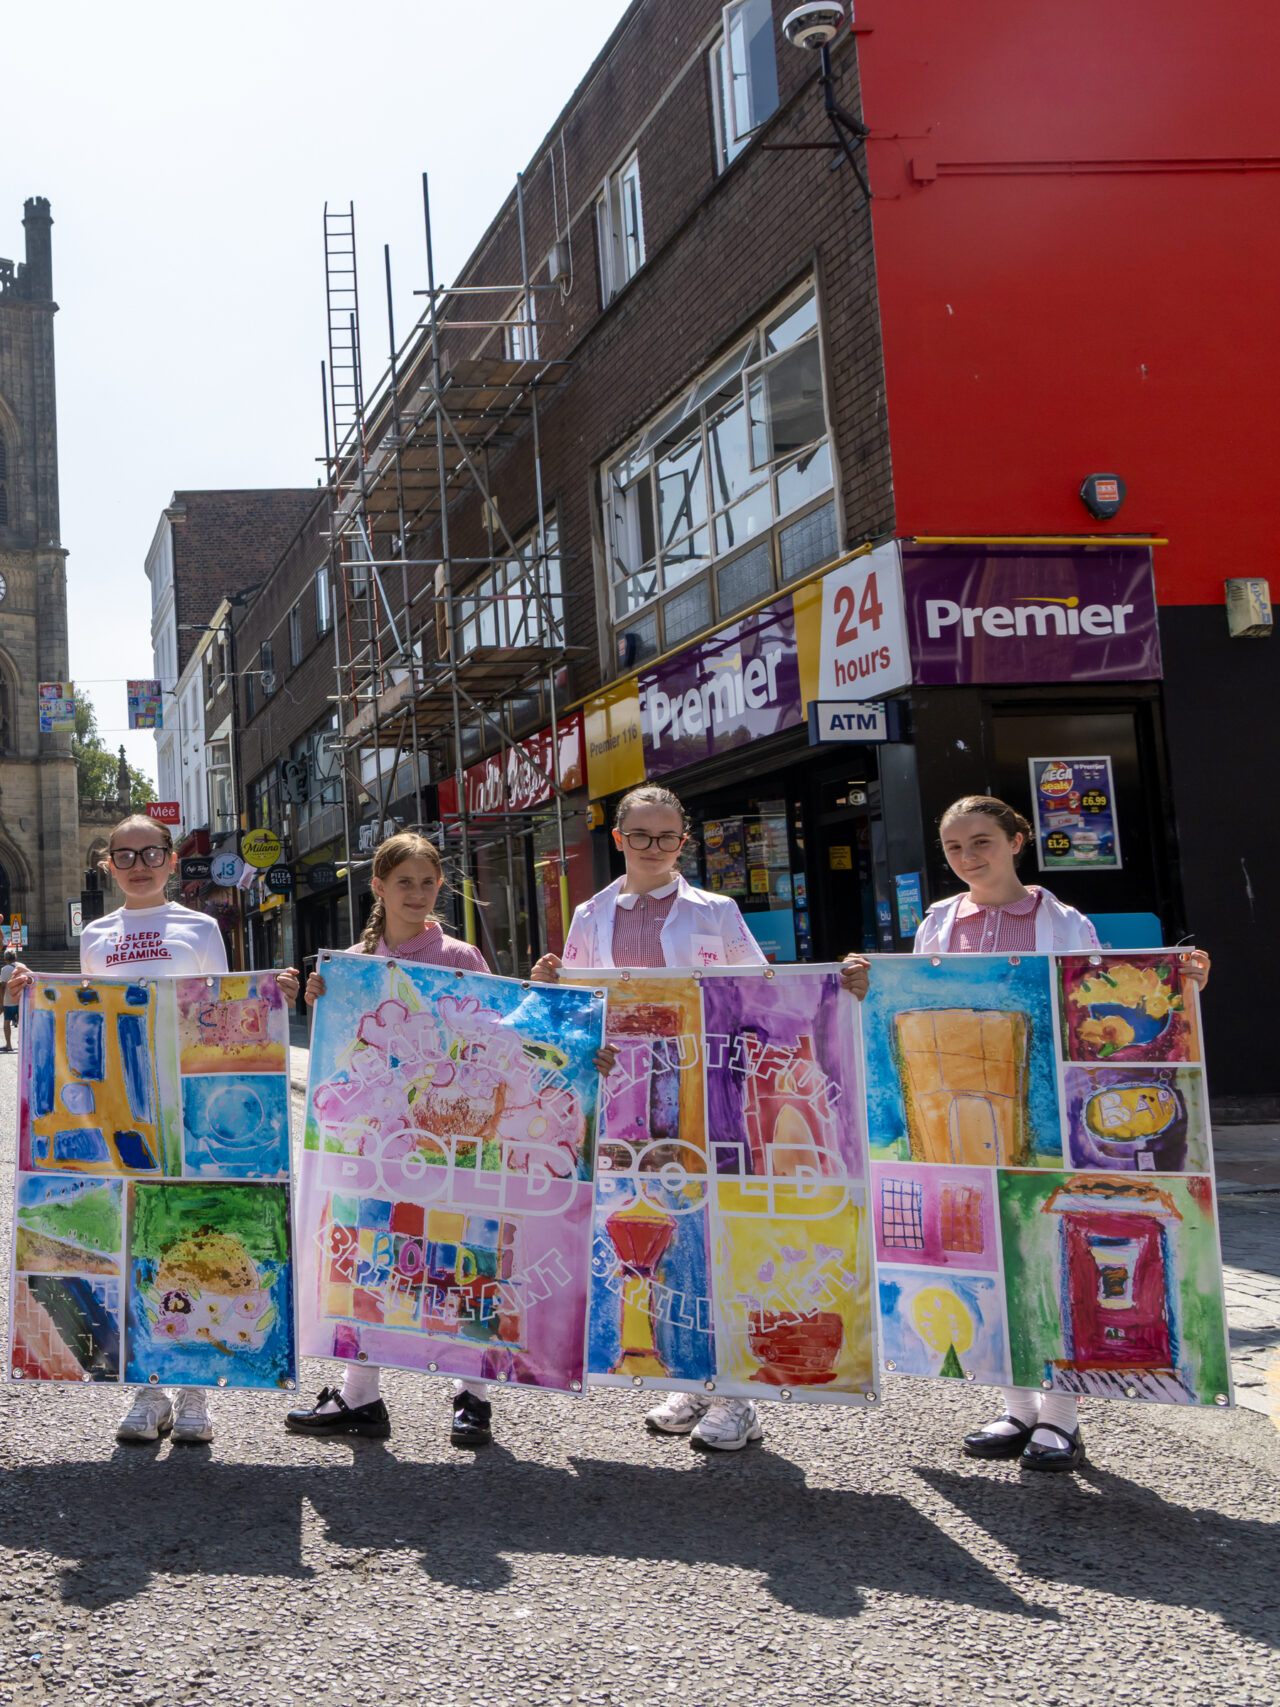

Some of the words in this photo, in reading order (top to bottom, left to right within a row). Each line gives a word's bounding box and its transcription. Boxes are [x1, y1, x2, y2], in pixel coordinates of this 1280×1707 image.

[833, 571, 884, 647] 24
[925, 596, 1134, 639] Premier
[834, 645, 891, 686] hours
[650, 646, 783, 749] Premier
[590, 732, 621, 758] Premier
[622, 724, 638, 743] 116
[828, 711, 878, 732] ATM
[1041, 767, 1073, 783] MEGA
[1082, 796, 1107, 806] £6.99
[1048, 840, 1070, 849] £1.25
[880, 910, 892, 920] blu
[106, 948, 171, 964] DREAMING.
[114, 943, 130, 952] TO
[132, 940, 163, 949] KEEP
[126, 932, 160, 941] SLEEP
[324, 1028, 582, 1125] BEAUTIFUL
[600, 1034, 842, 1122] EAUTIFUL
[1098, 1089, 1176, 1129] BAR
[319, 1120, 579, 1217] BOLD
[597, 1138, 851, 1220] BOLD
[312, 1218, 573, 1322] BRILLIANT
[372, 1231, 478, 1285] BOLD
[590, 1236, 856, 1333] BRILLIANT
